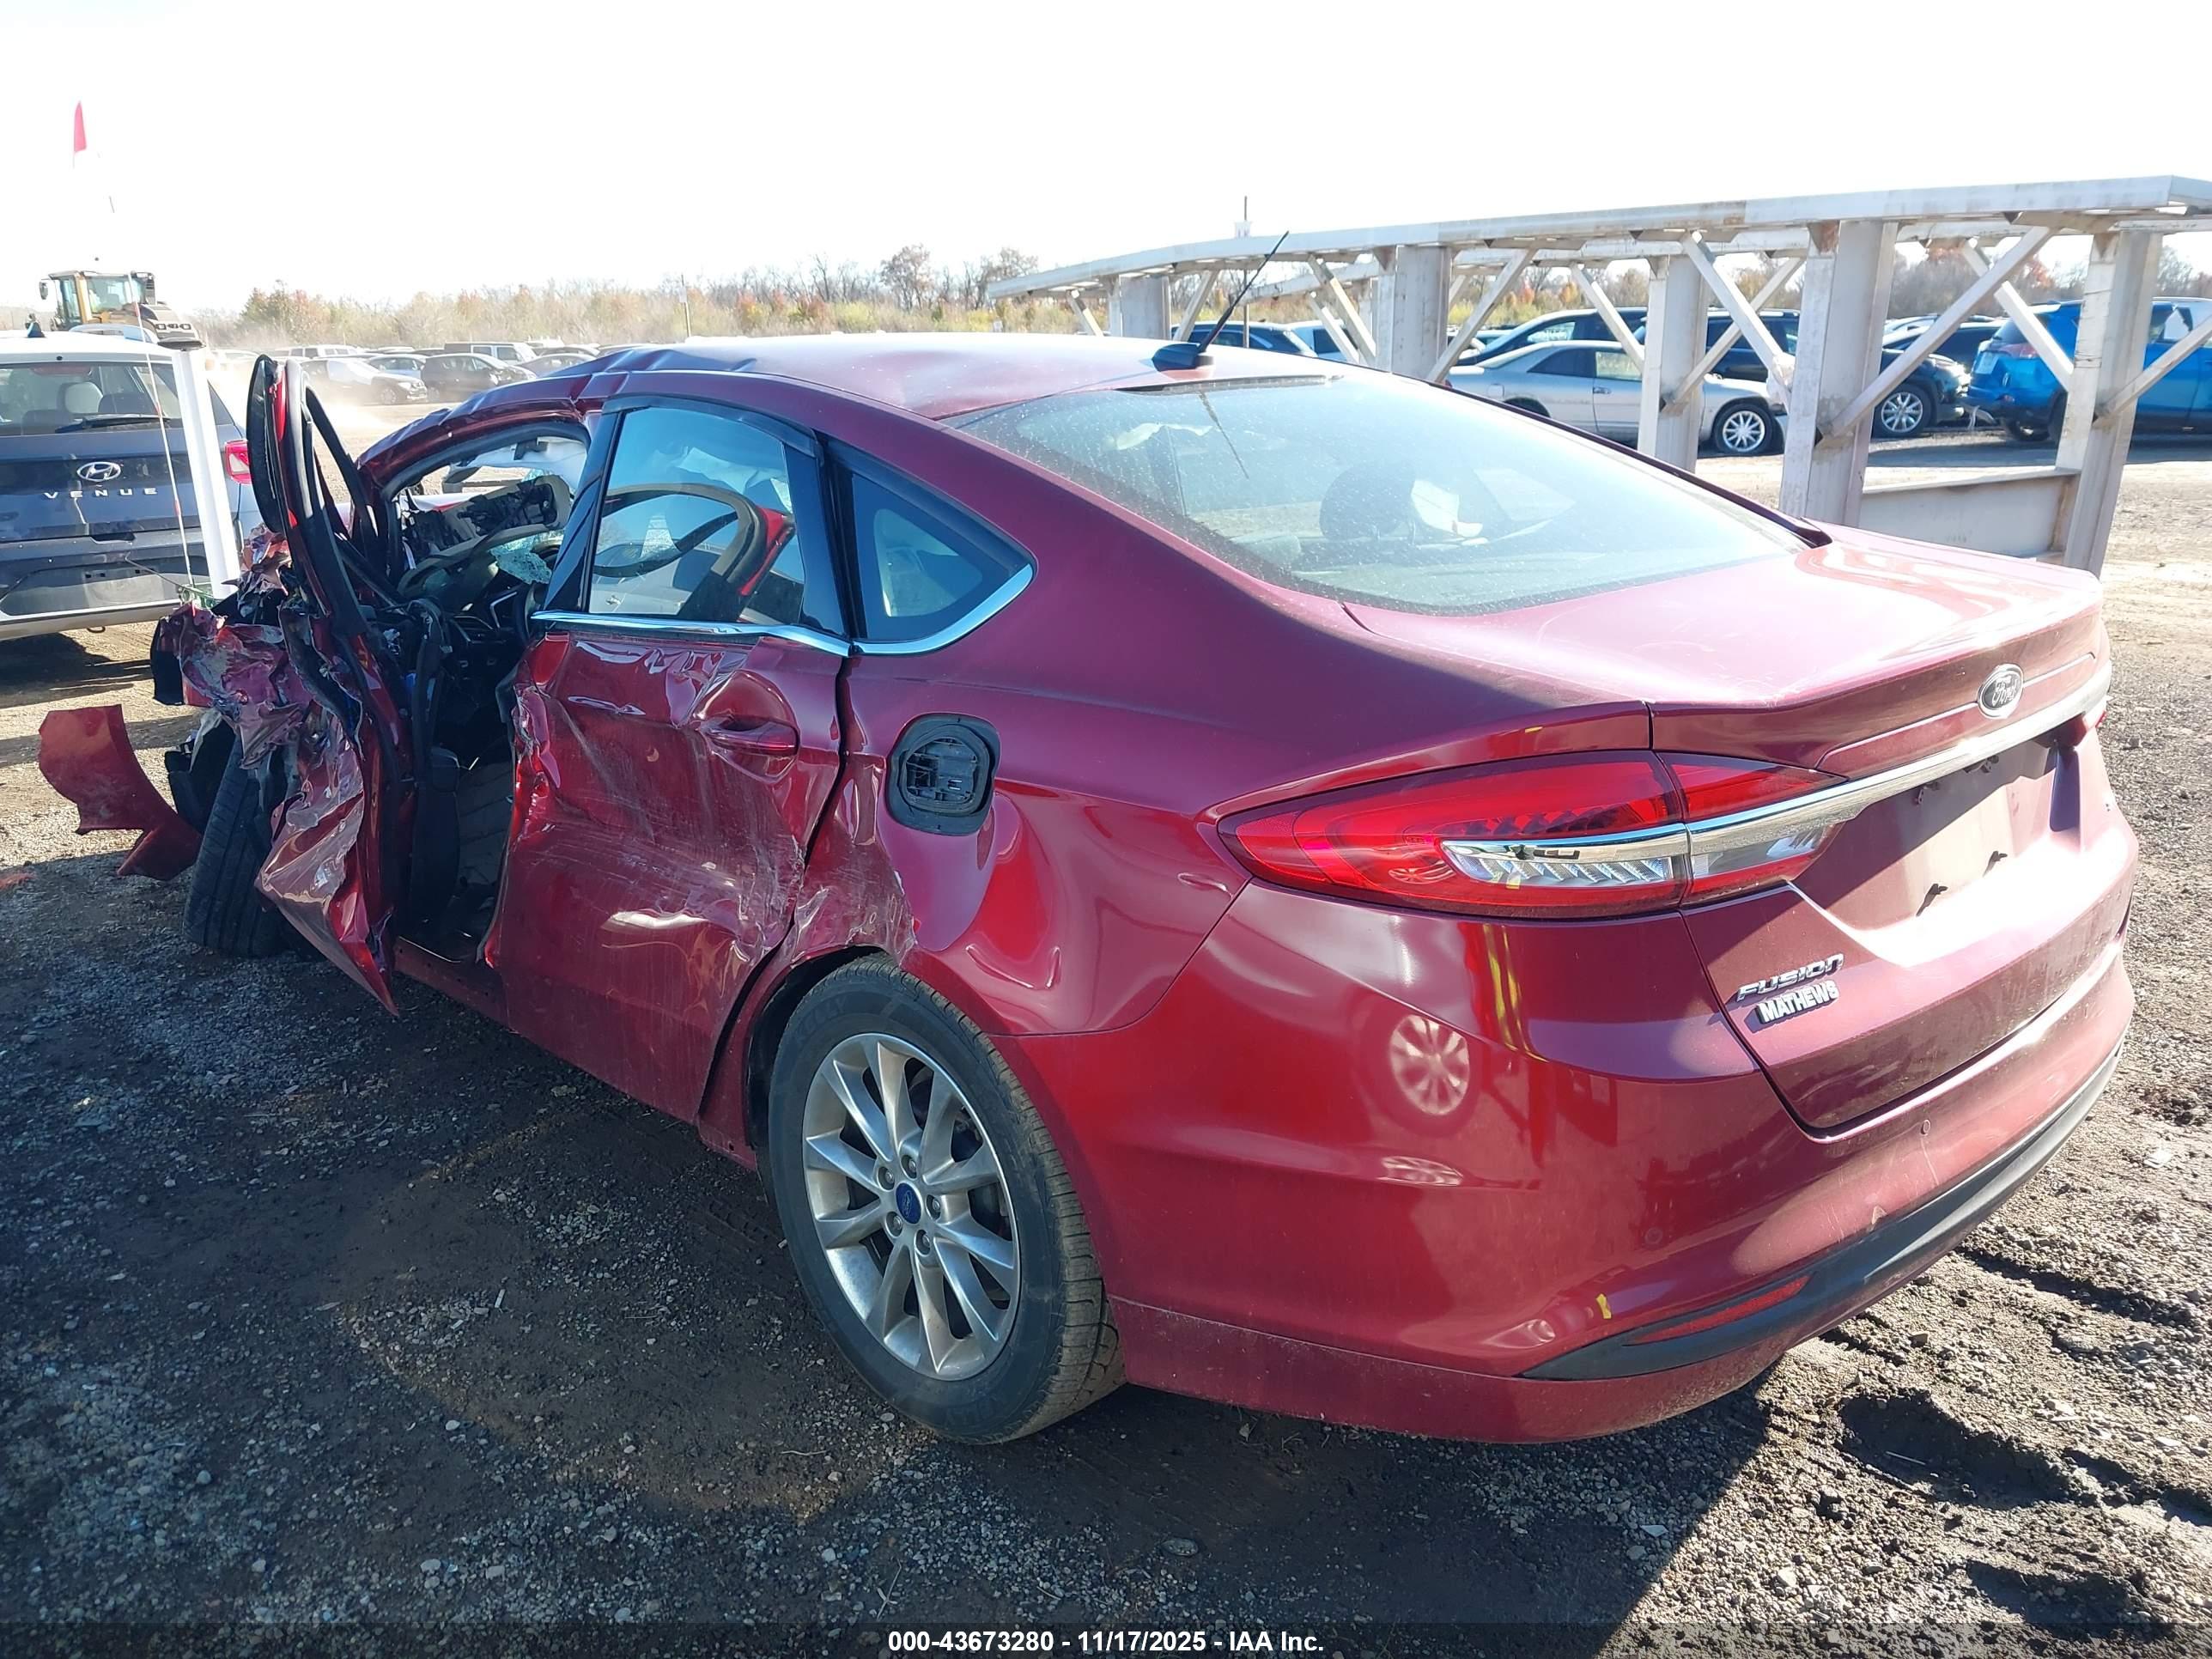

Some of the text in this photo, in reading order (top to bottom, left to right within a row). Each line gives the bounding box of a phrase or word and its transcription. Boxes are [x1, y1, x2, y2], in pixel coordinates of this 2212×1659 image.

[43, 487, 158, 499] VENUE
[1736, 953, 1844, 1002] FUSION
[1756, 980, 1840, 1024] MATHEWS
